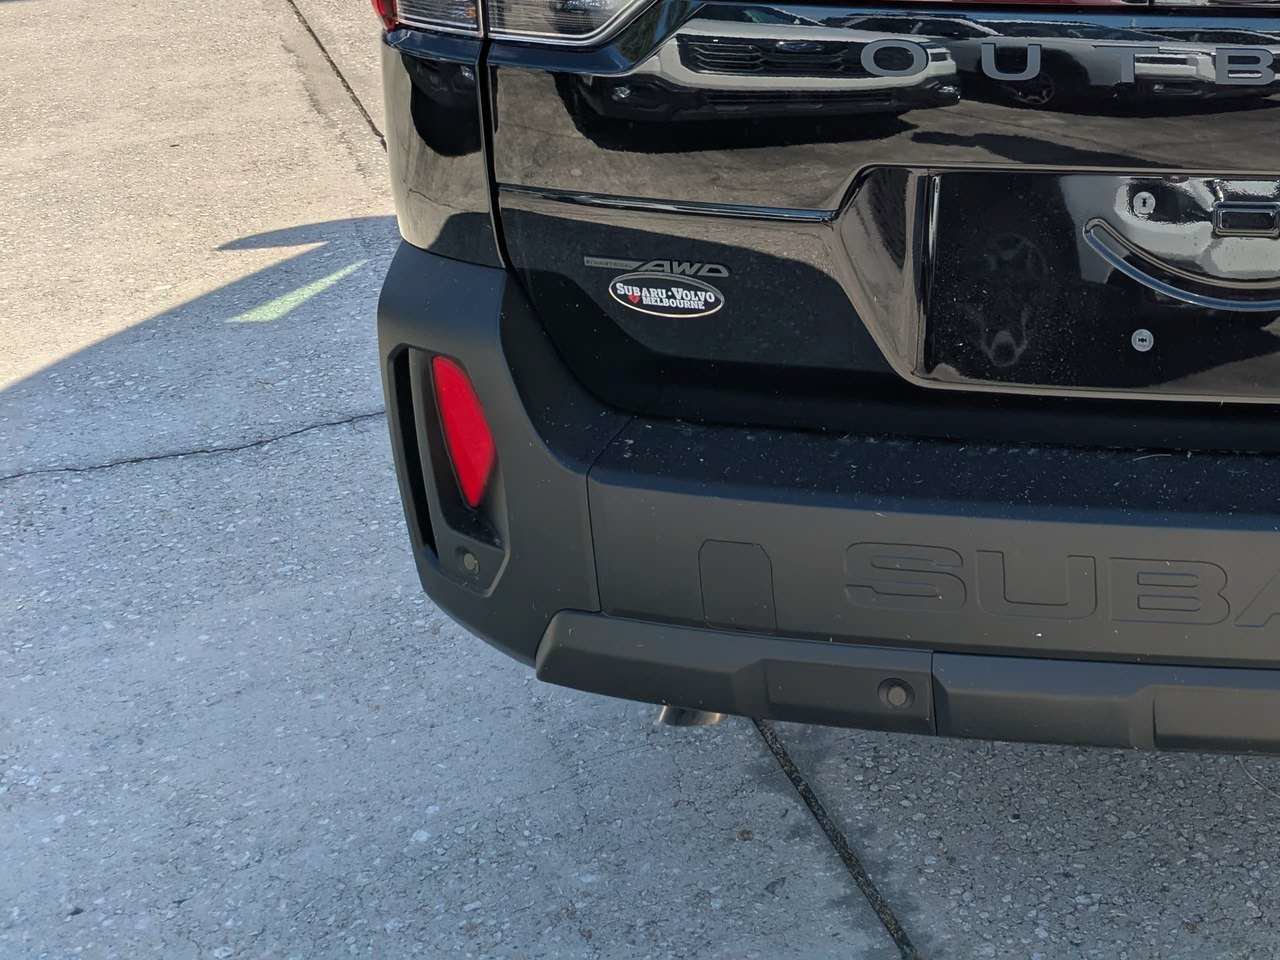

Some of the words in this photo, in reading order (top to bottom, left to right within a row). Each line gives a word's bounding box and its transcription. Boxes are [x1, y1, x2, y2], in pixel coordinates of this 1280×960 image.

[636, 259, 730, 278] AWD
[615, 282, 667, 299] SUBARU
[670, 287, 716, 303] VOLVO
[641, 295, 706, 310] MELBOURNE
